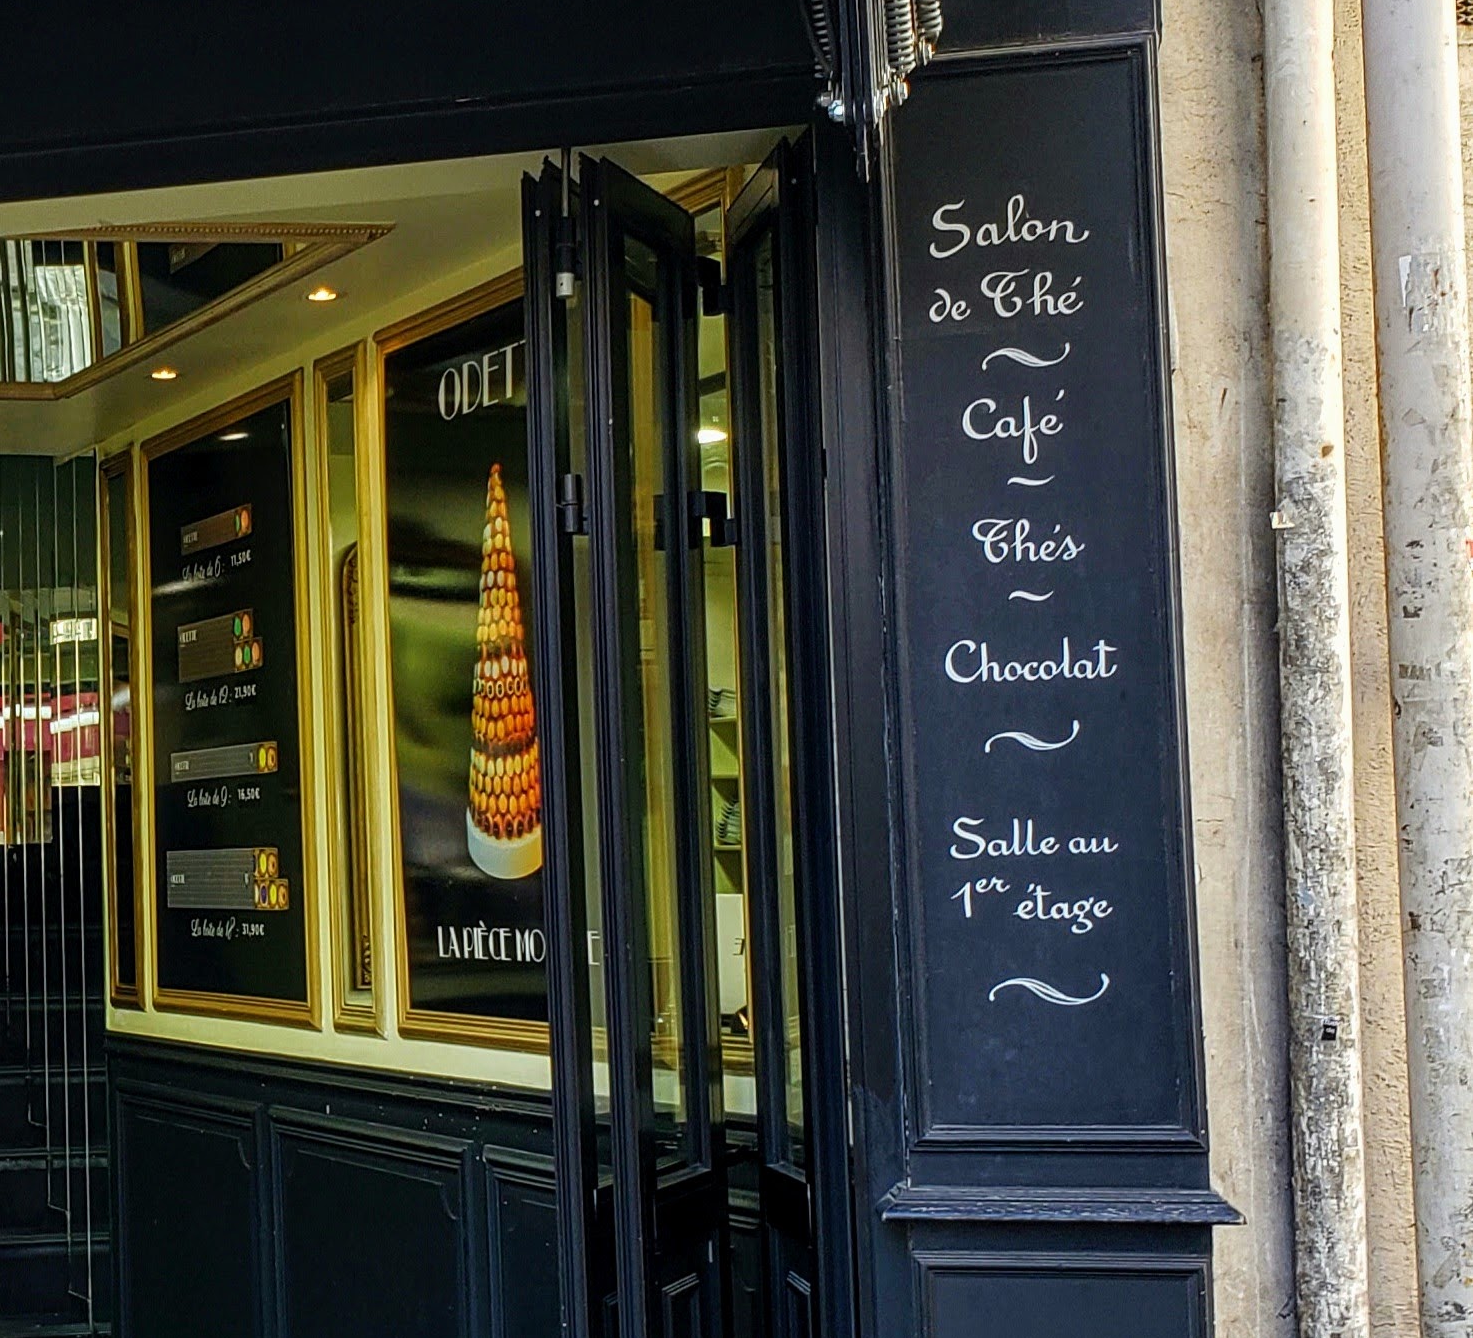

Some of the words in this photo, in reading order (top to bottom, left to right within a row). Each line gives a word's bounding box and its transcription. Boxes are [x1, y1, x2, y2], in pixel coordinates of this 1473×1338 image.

[930, 195, 1089, 258] Salon
[930, 289, 970, 322] de
[981, 269, 1083, 317] Thé
[963, 390, 1064, 464] Café
[972, 519, 1085, 563] Thés
[945, 637, 1117, 683] Chocolat
[950, 817, 1059, 858] Salle
[1069, 837, 1118, 853] au
[951, 877, 1010, 917] 1er
[1013, 884, 1112, 933] étage
[437, 925, 461, 959] LA
[462, 919, 513, 961] PIÈCE
